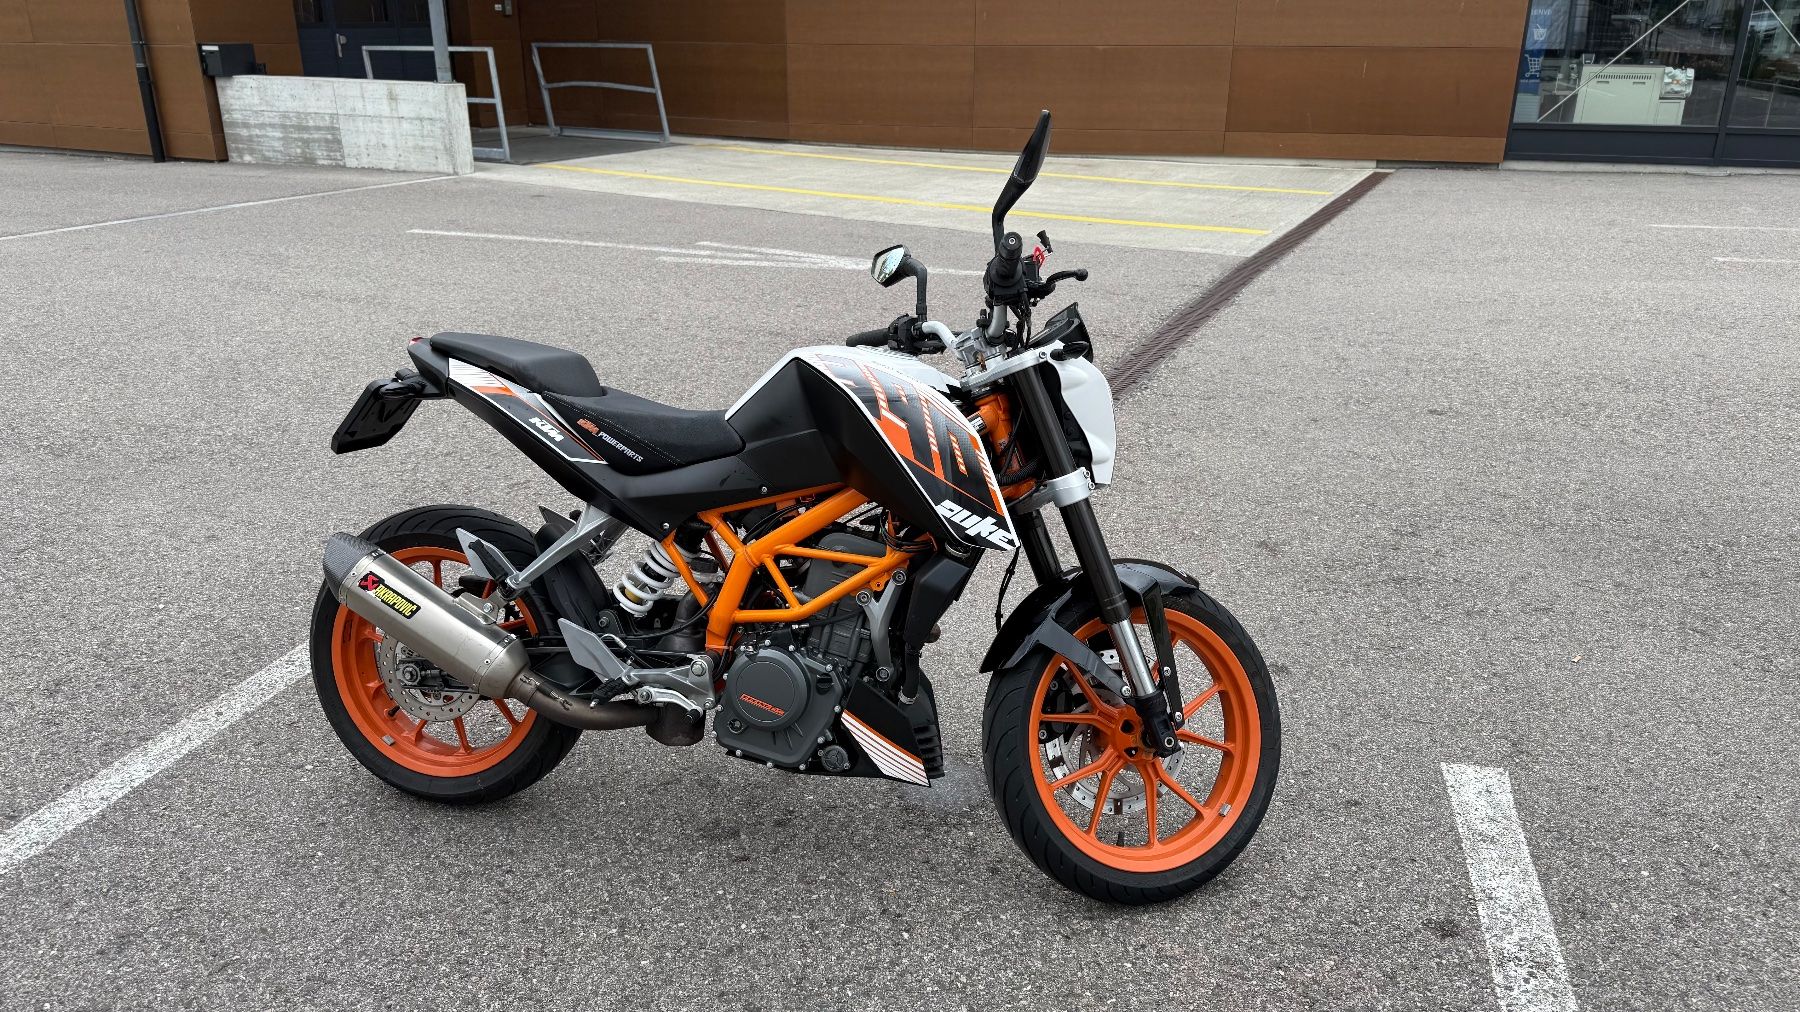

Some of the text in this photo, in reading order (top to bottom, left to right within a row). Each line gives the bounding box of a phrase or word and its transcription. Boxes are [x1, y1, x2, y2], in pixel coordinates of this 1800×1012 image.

[528, 416, 564, 442] KTM
[598, 431, 643, 463] POWERPARTS
[935, 499, 1017, 550] DUKE
